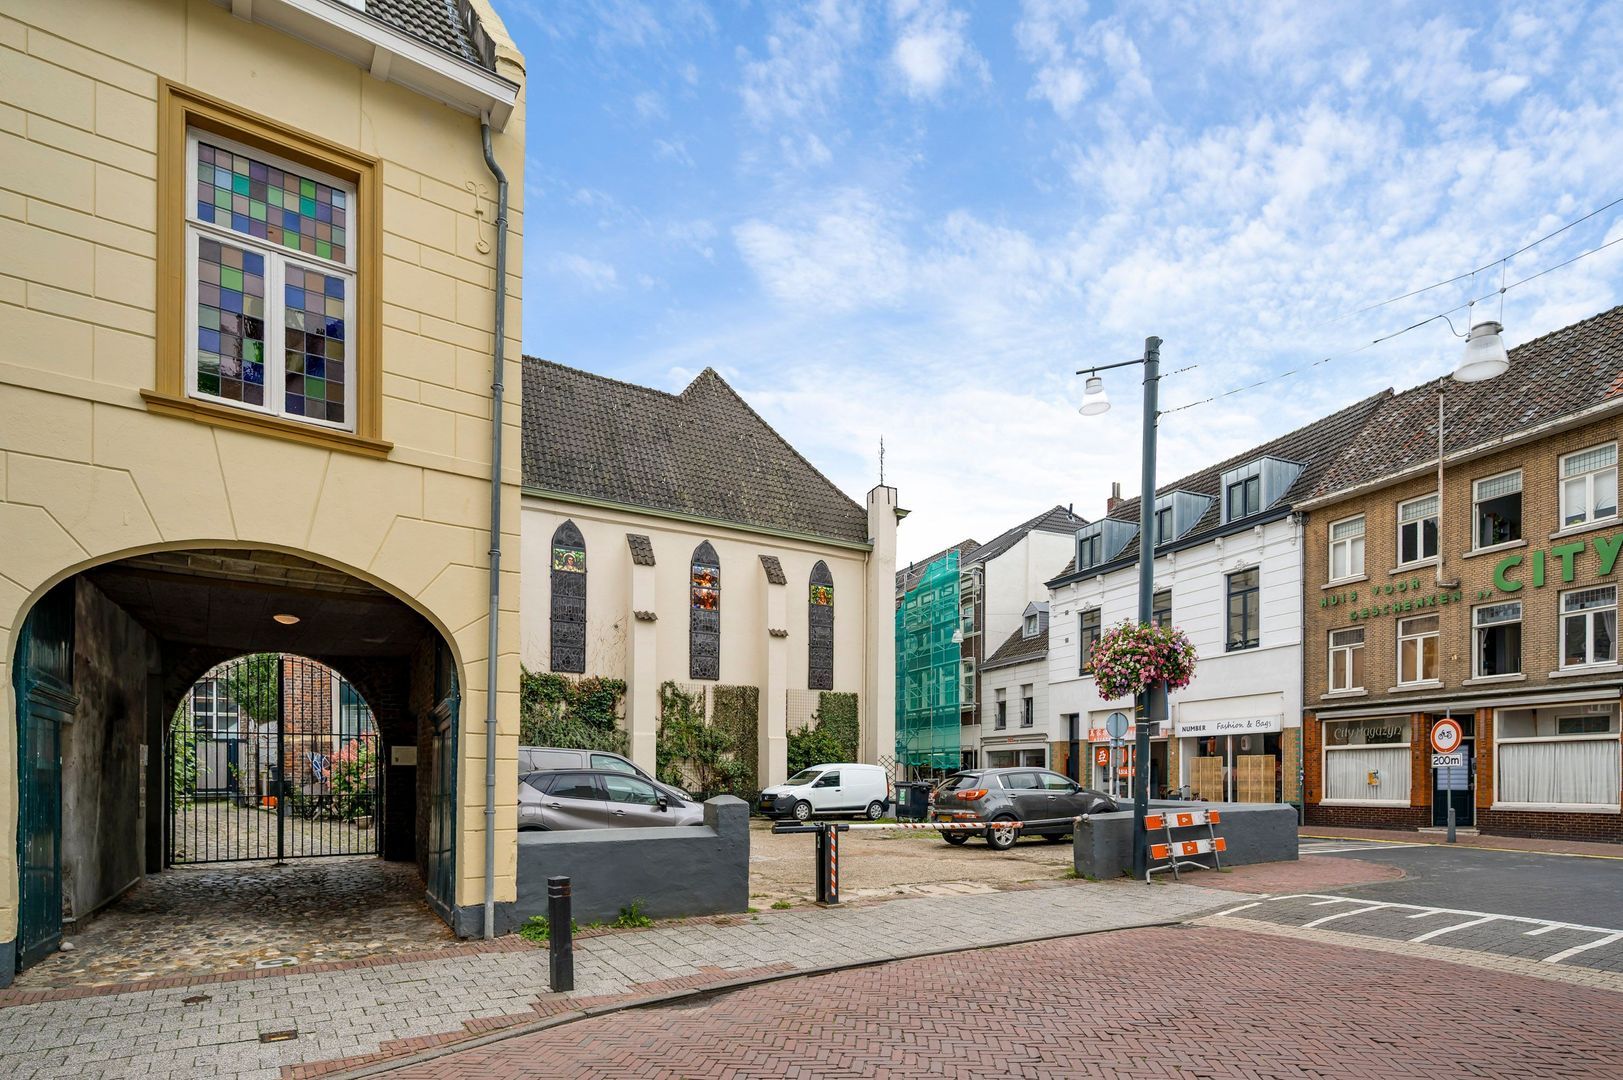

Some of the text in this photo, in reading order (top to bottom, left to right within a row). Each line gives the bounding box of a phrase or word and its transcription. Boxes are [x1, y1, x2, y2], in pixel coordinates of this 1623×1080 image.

[1319, 577, 1421, 608] HUIS VOOR
[1349, 590, 1462, 621] GESCHENKEN
[1181, 719, 1272, 733] NUMBER Fashion & Bags
[1333, 727, 1355, 740] City
[1432, 755, 1460, 766] 200m
